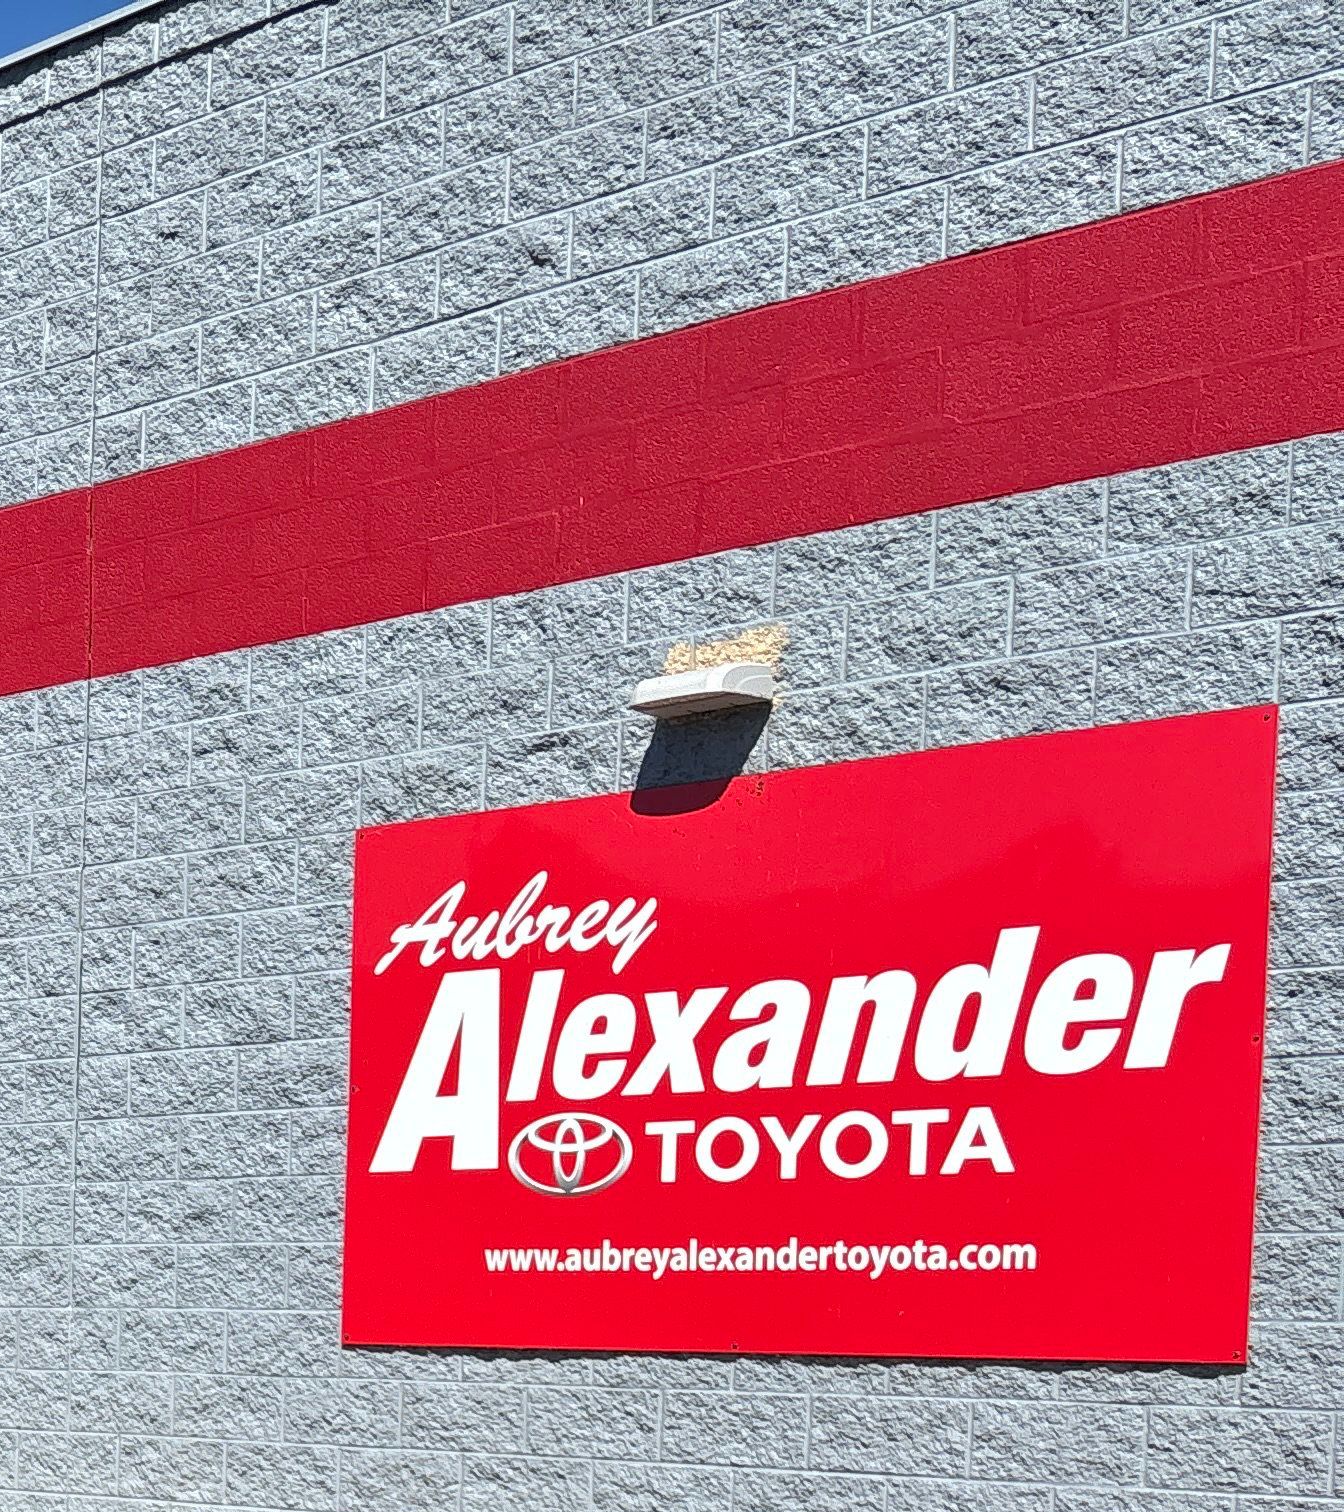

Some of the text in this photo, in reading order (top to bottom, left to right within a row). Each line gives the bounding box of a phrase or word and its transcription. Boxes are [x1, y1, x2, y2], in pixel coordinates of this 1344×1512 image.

[374, 870, 658, 976] Aubrey
[368, 925, 1232, 1174] Alexander
[644, 1106, 1016, 1184] TOYOTA
[484, 1236, 1037, 1281] www.aubreyalexandertoyota.com
